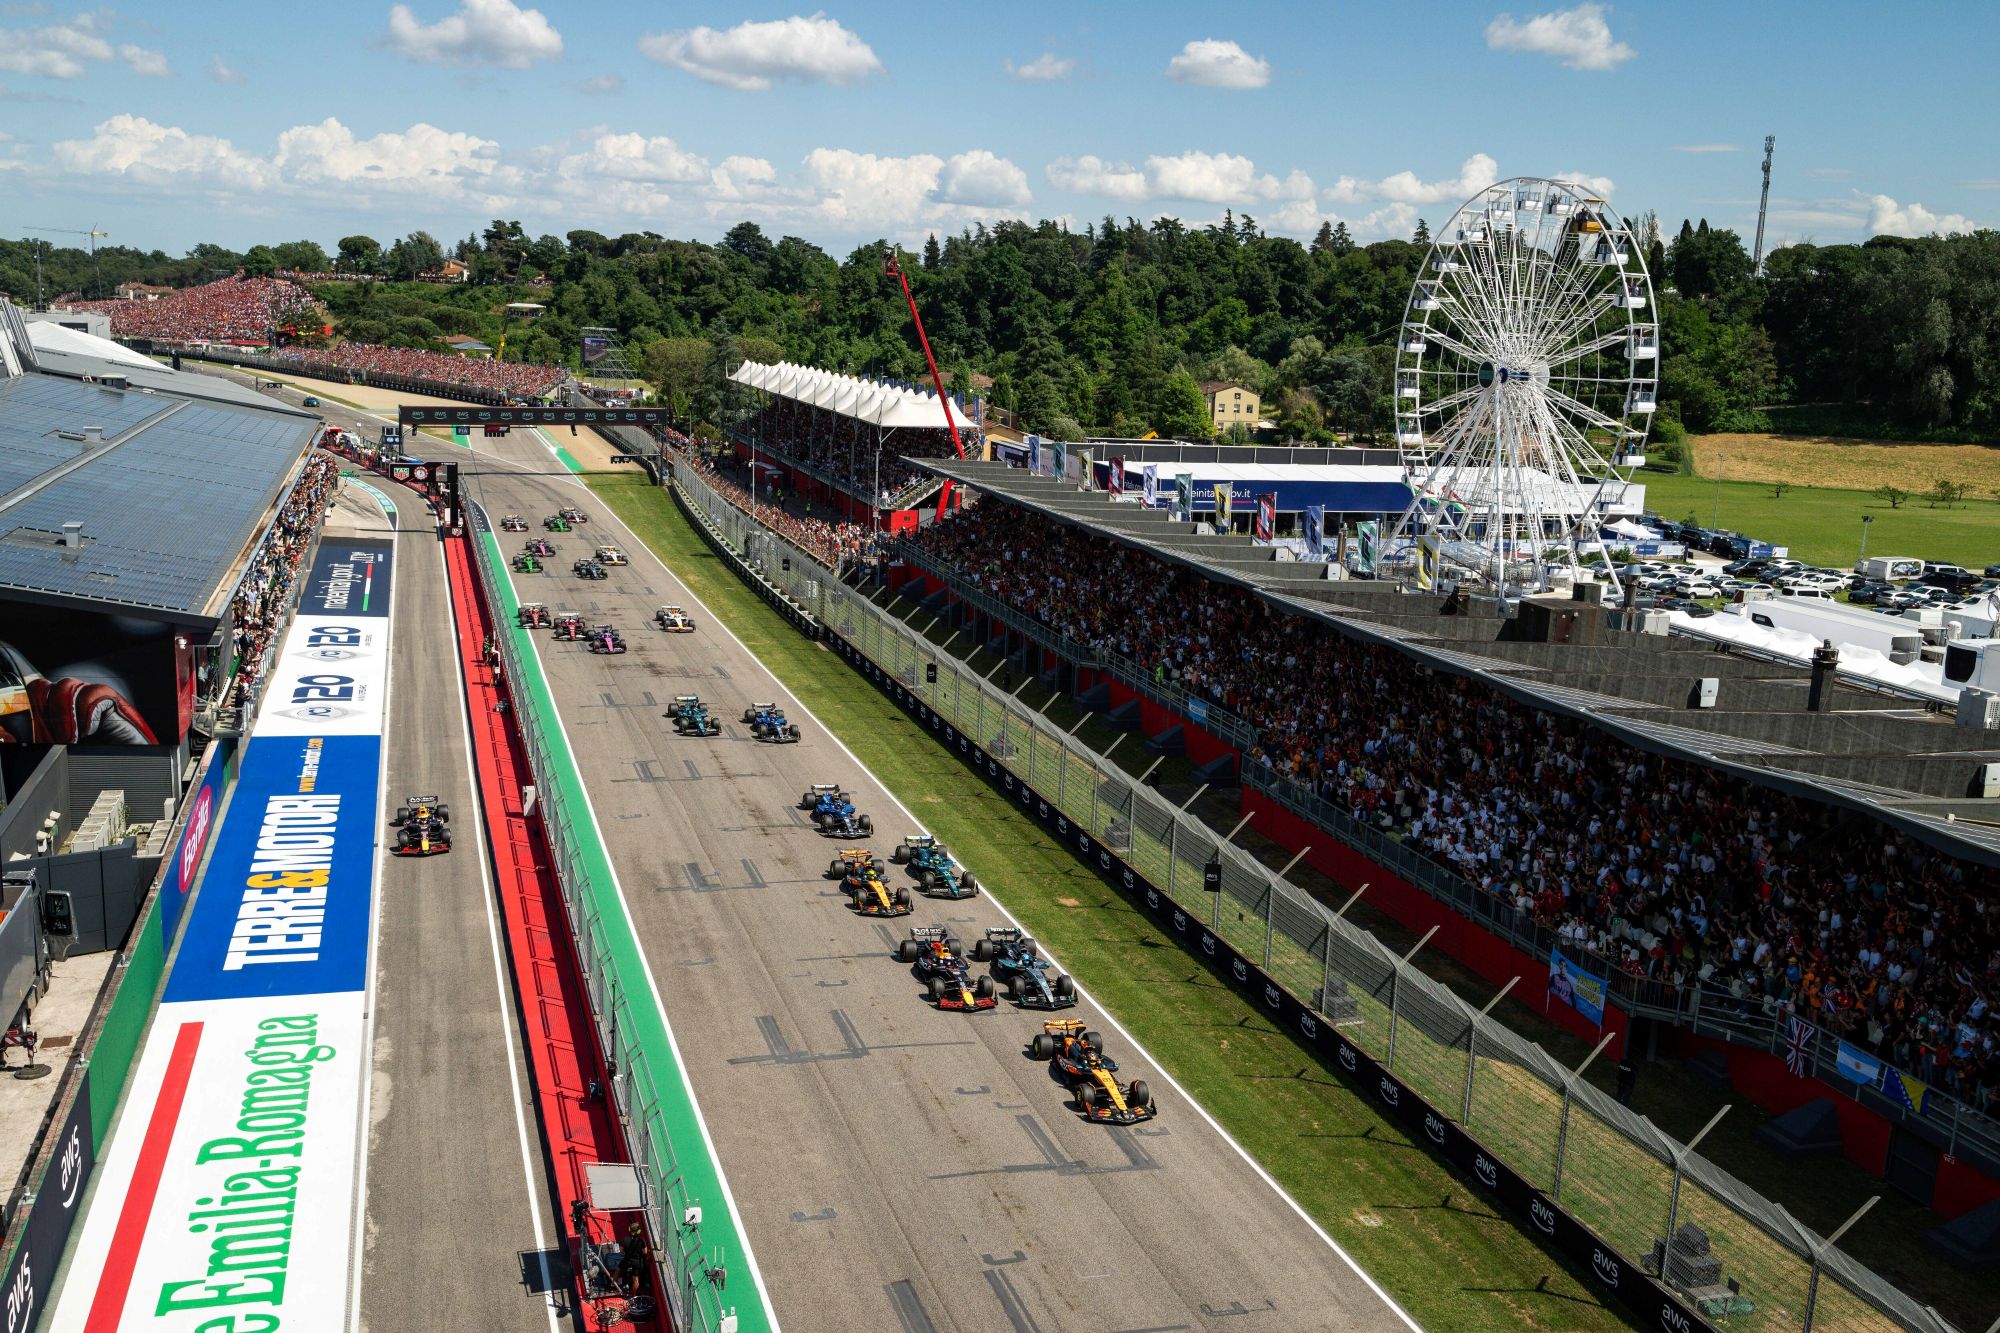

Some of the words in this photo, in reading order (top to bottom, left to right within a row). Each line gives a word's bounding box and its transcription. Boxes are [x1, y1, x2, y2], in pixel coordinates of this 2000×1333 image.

[307, 626, 361, 647] 120
[291, 675, 354, 703] 120
[184, 796, 209, 882] Barilla
[1203, 933, 1214, 949] aws
[1233, 958, 1246, 974] aws
[1266, 984, 1279, 1001] aws
[1301, 1012, 1315, 1032] aws
[1339, 1044, 1355, 1063] aws
[1381, 1077, 1398, 1099] aws
[1425, 1113, 1444, 1136] aws
[61, 1124, 80, 1191] aws
[1476, 1154, 1496, 1178] aws
[1532, 1199, 1554, 1226] aws
[1594, 1249, 1618, 1277] aws
[7, 1252, 31, 1333] aws
[1662, 1303, 1690, 1333] aws
